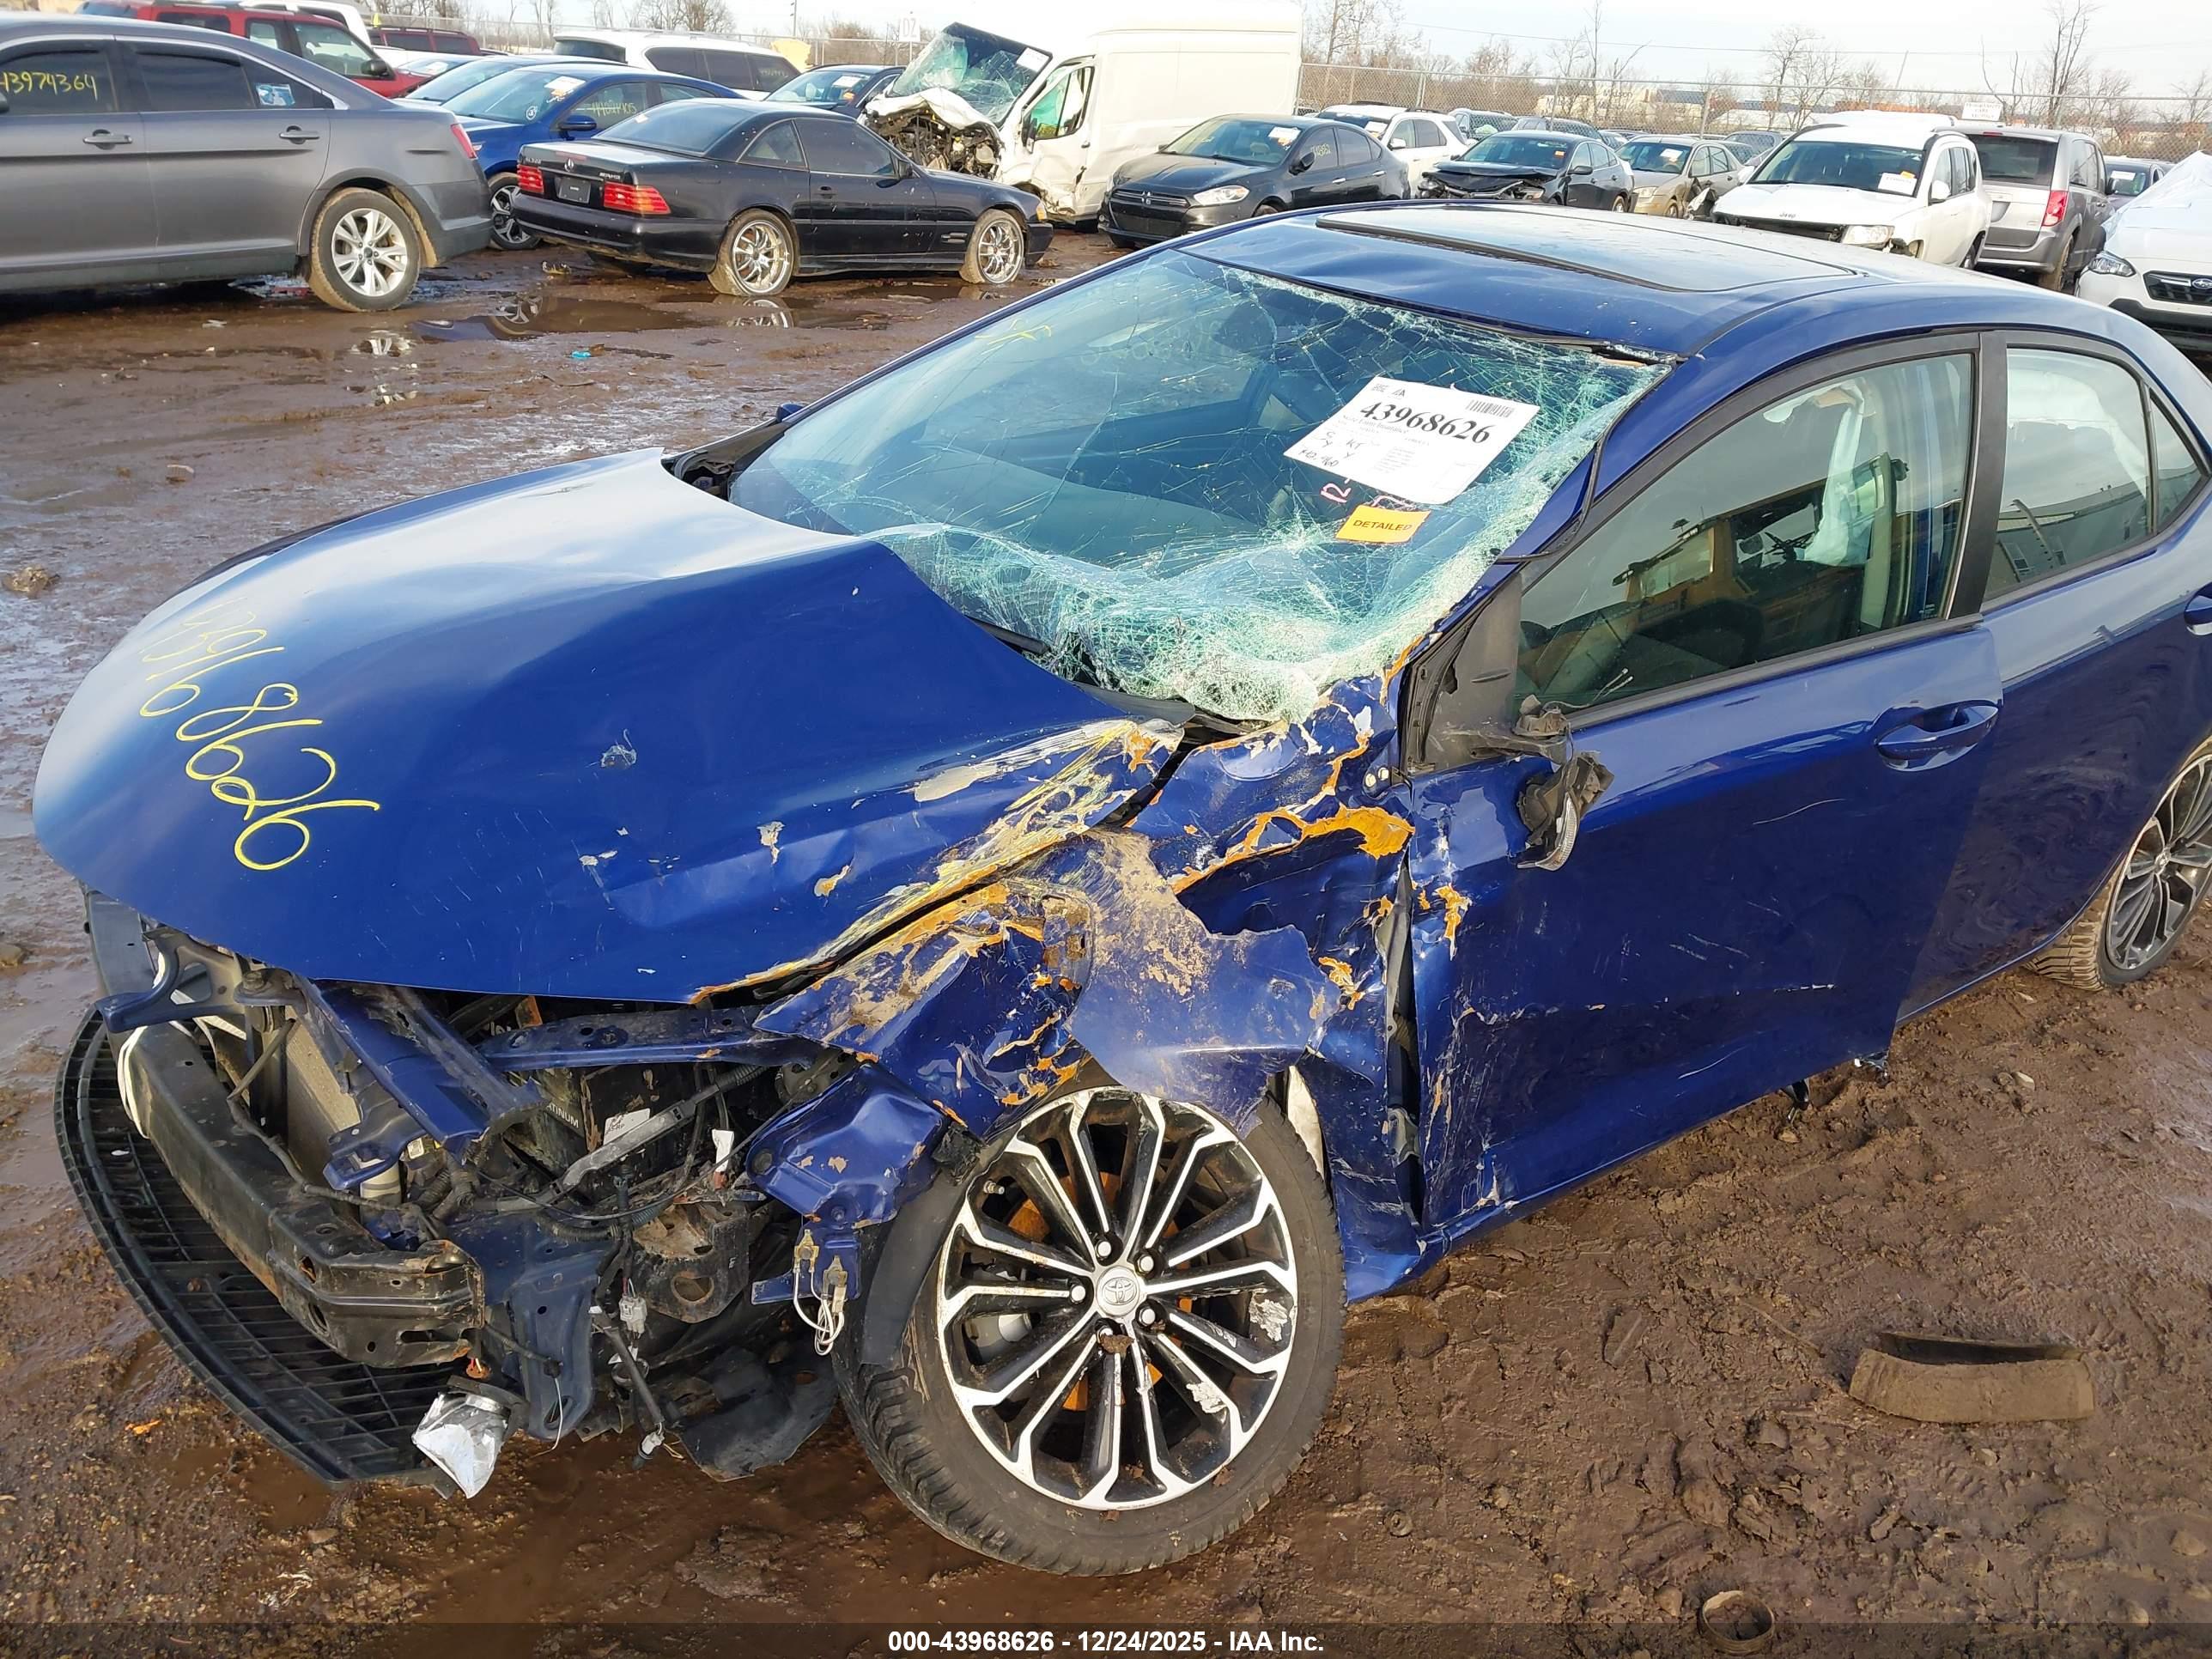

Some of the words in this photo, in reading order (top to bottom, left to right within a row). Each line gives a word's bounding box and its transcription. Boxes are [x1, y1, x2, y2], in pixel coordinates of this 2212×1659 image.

[1360, 401, 1496, 444] 43968626
[1353, 519, 1413, 532] DETAILED
[546, 1102, 579, 1128] ATINUM
